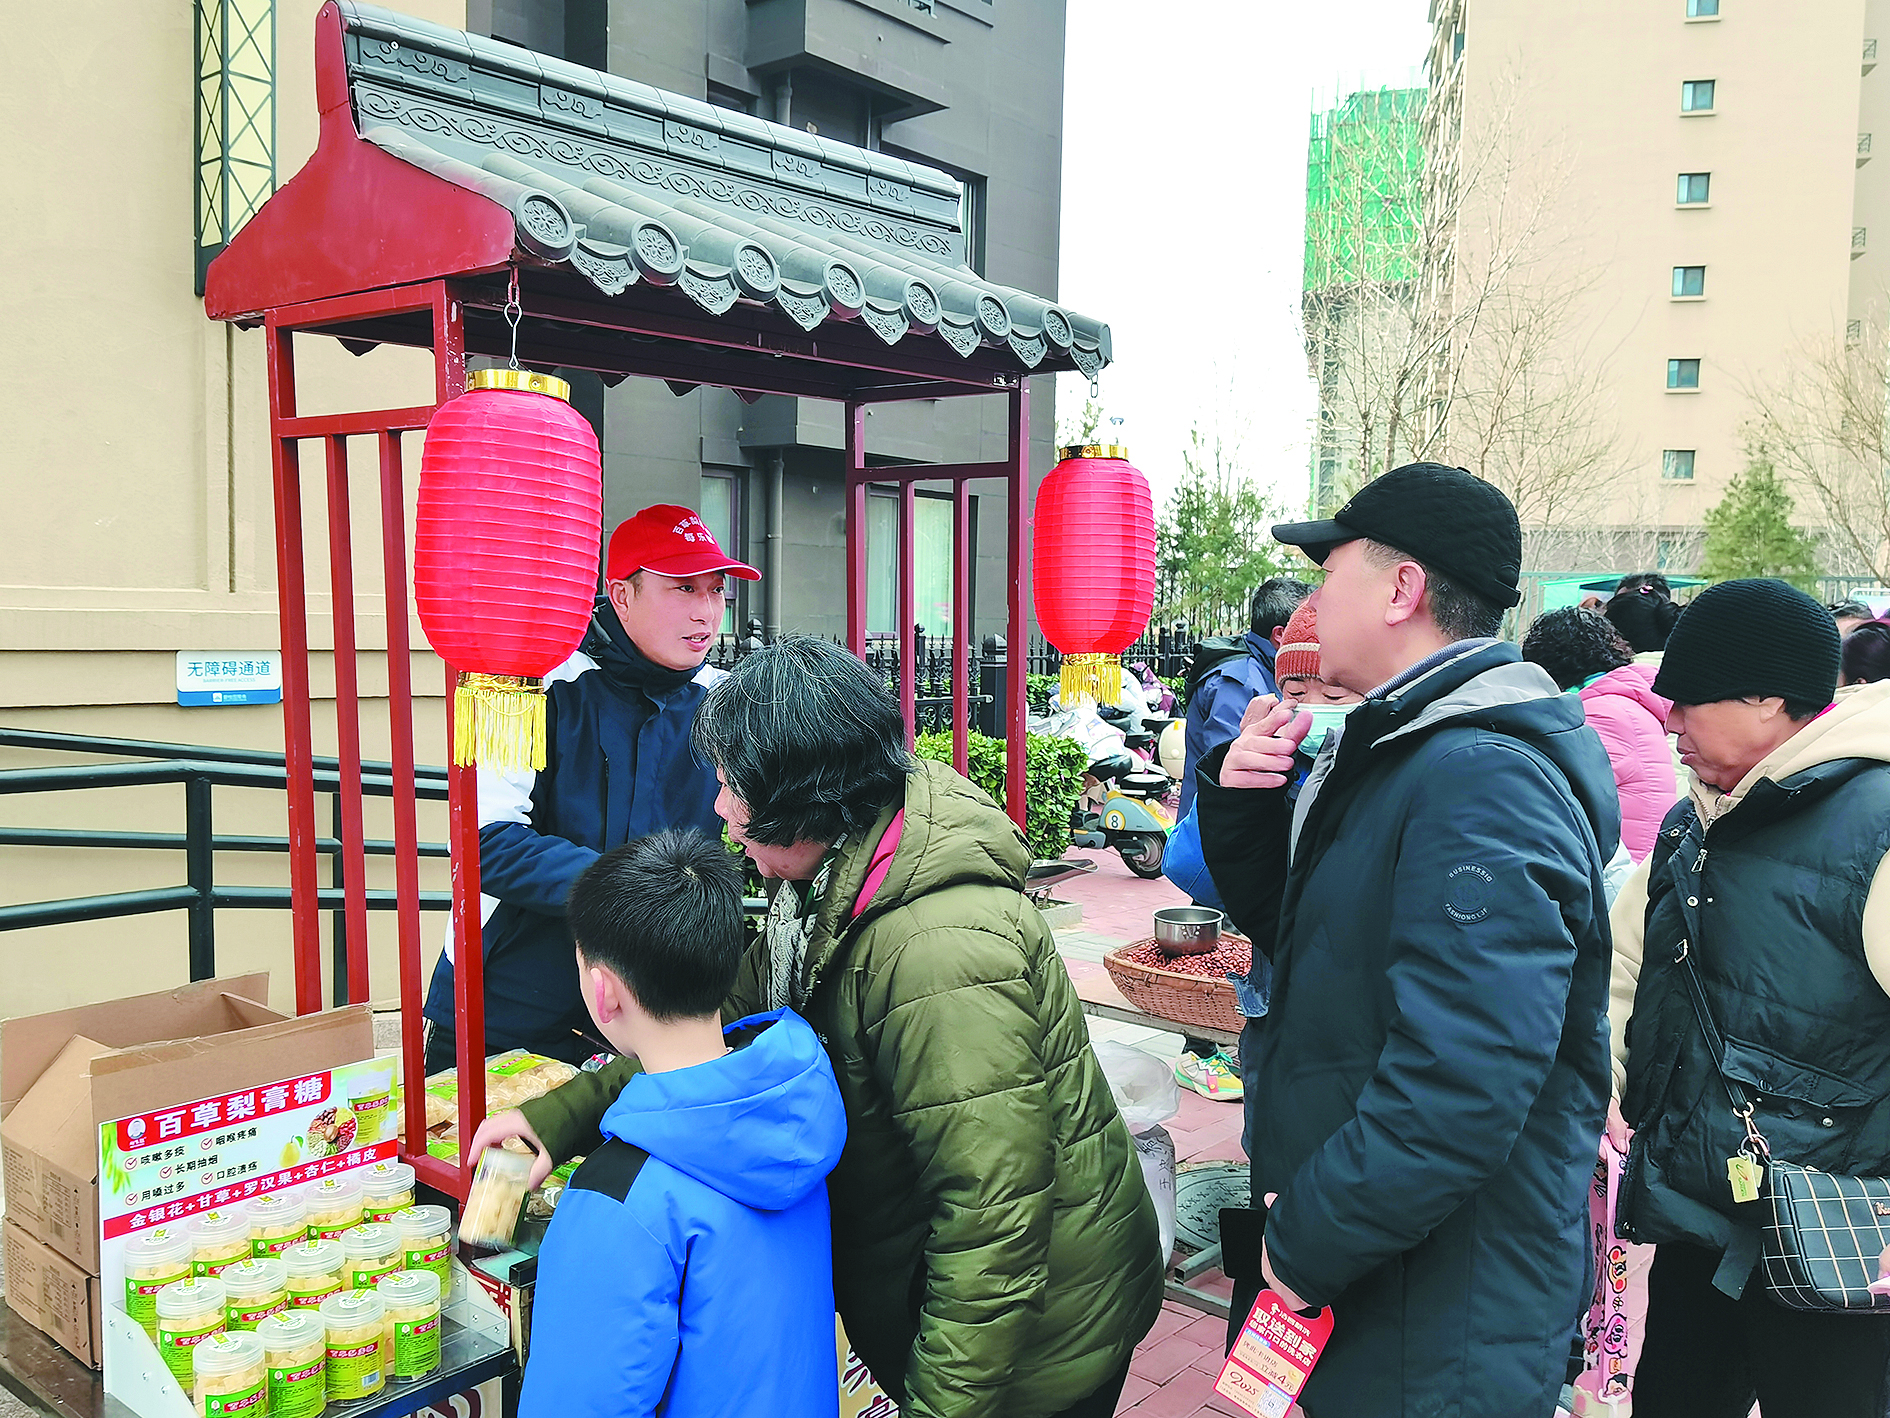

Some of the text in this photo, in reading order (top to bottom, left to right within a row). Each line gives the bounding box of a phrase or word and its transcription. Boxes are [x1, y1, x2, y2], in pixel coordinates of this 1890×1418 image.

[187, 660, 271, 677] 无障碍通道
[1111, 815, 1119, 829] 8
[153, 1077, 323, 1138] 百草梨膏糖
[140, 1145, 185, 1165] 咳嗽多痰
[175, 1154, 218, 1175] 长期抽烟
[216, 1161, 258, 1180] 口腔溃疡
[129, 1148, 377, 1229] 金银花+甘草+罗汉果+杏仁+橘皮
[141, 1181, 185, 1202] 用嗓过多
[1252, 1306, 1318, 1360] 取送到家
[1229, 1371, 1259, 1396] 2025
